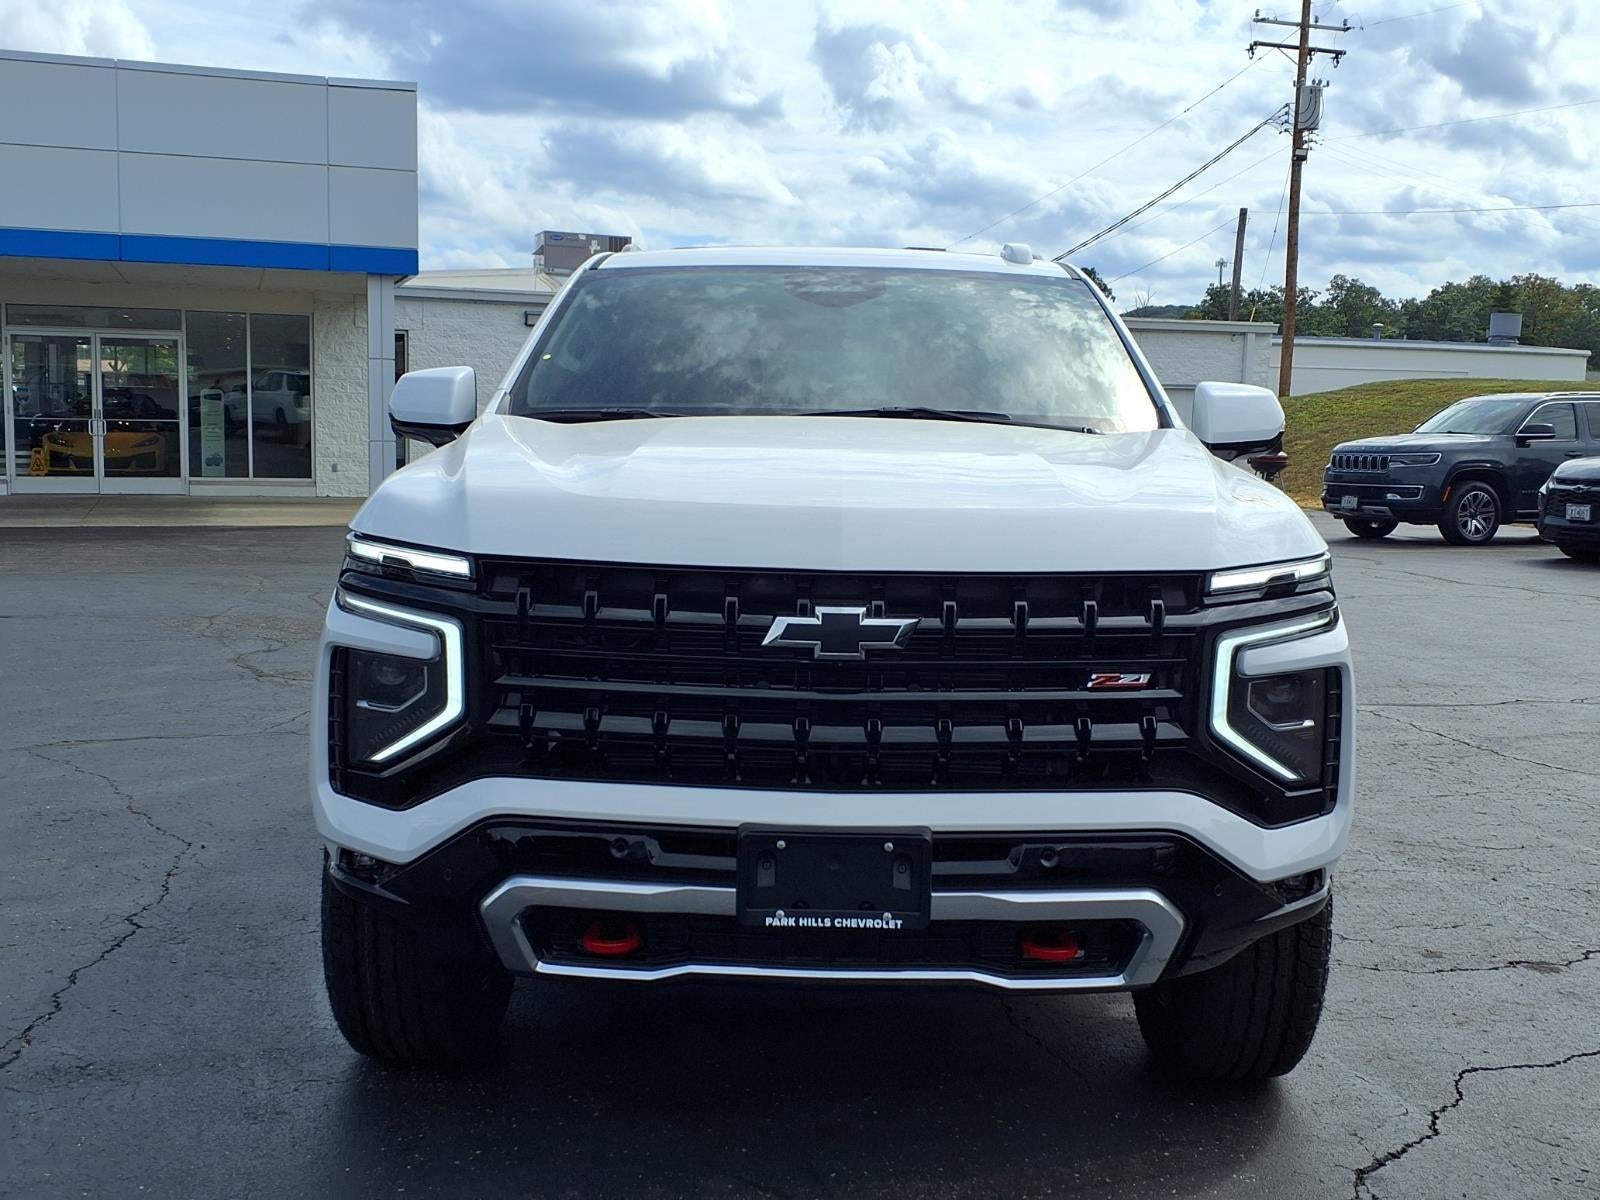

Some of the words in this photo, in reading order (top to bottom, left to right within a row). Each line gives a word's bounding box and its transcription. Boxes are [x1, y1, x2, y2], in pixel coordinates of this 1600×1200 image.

[765, 917, 796, 926] PARK
[799, 917, 831, 927] HILLS
[834, 918, 903, 929] CHEVROLET
